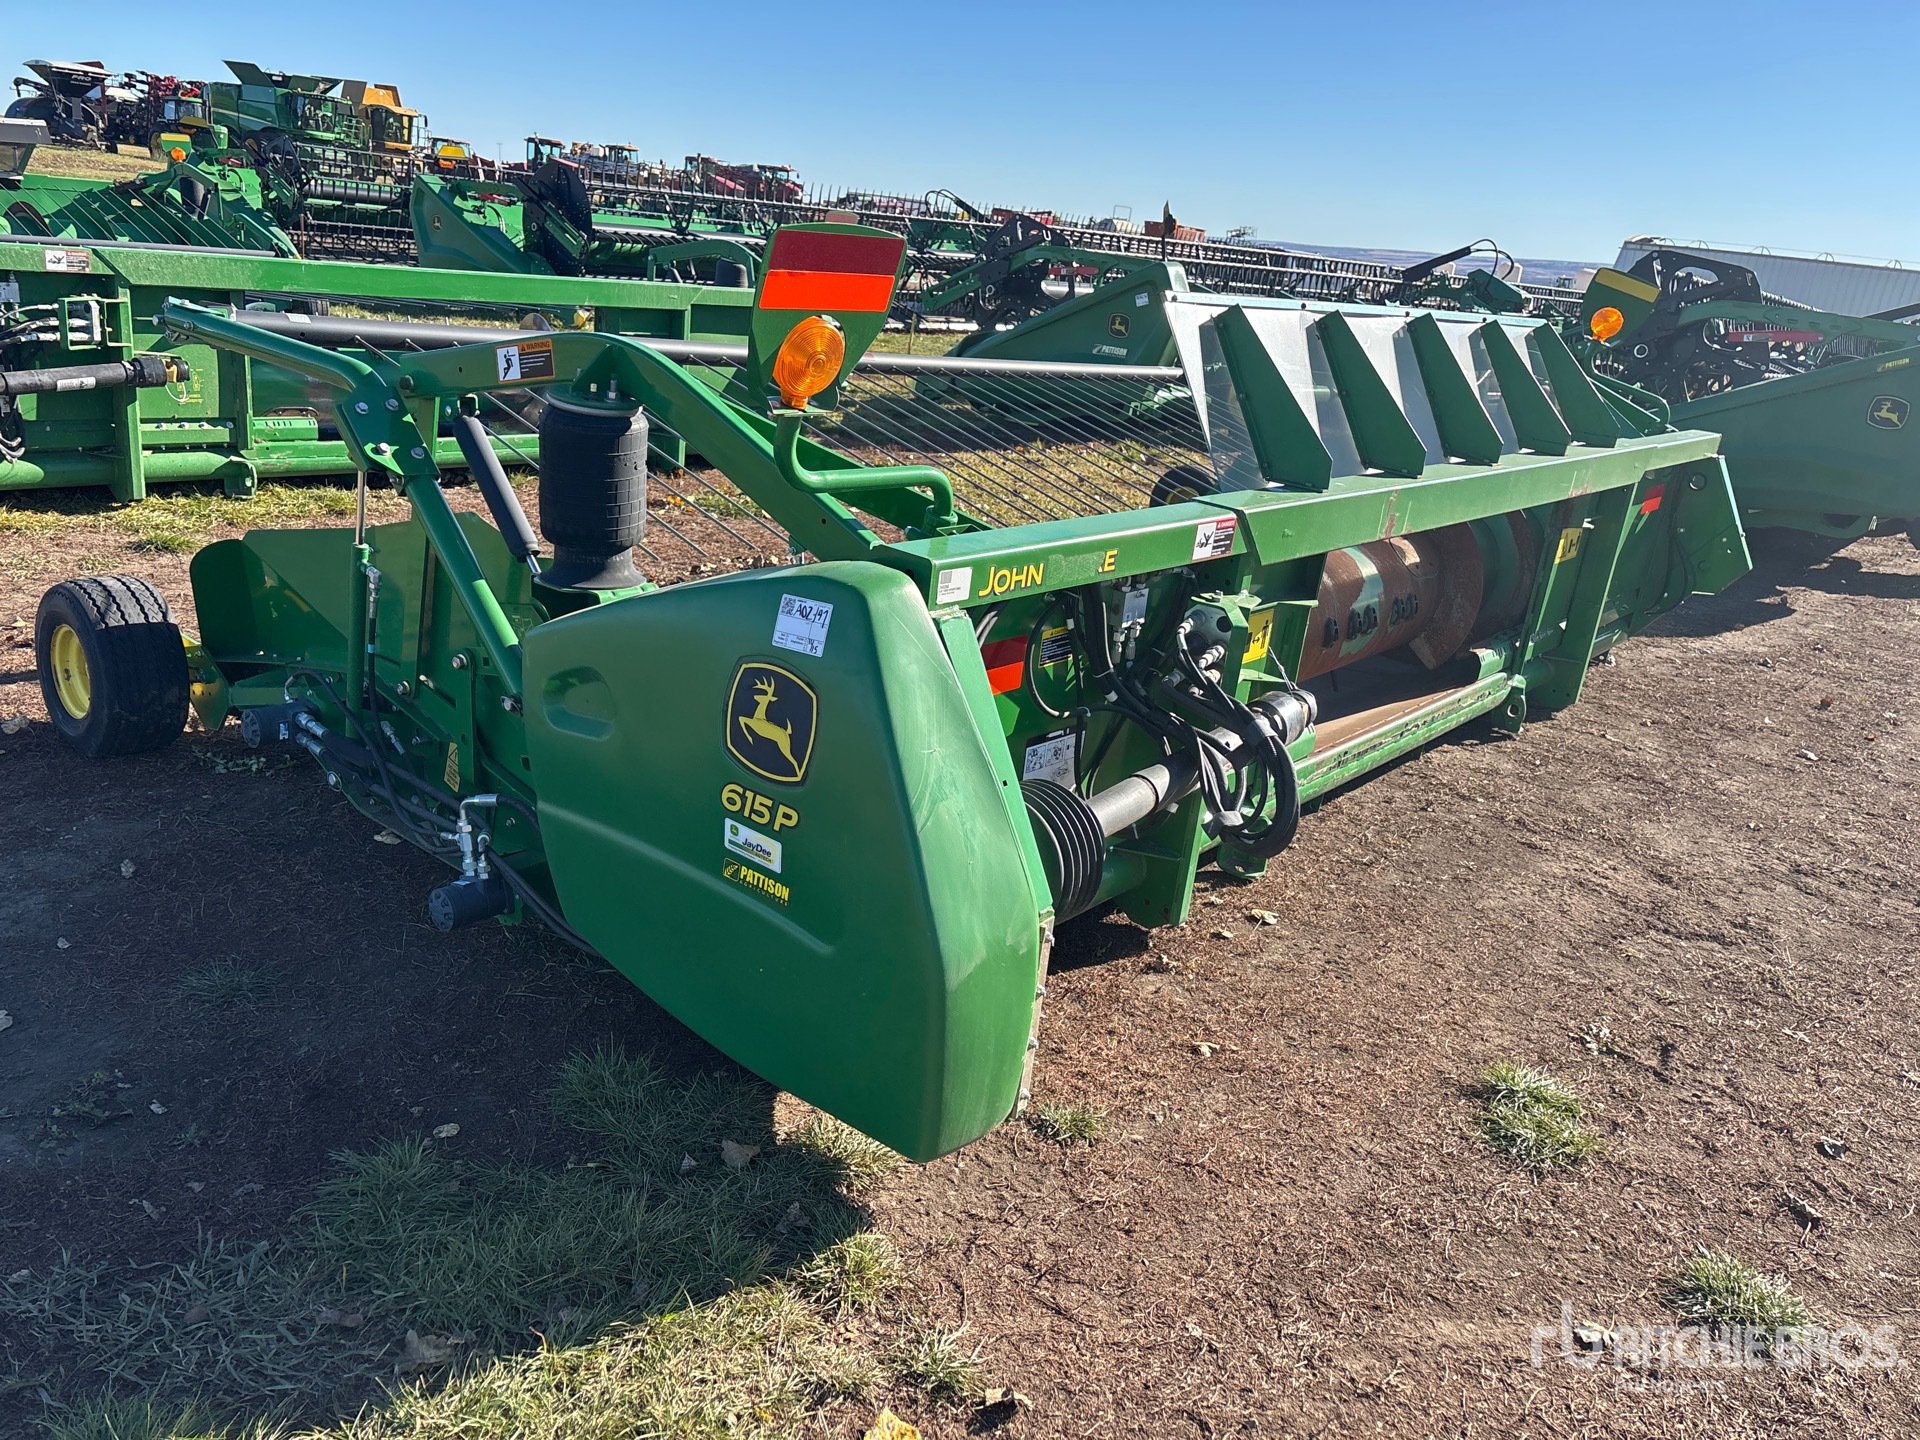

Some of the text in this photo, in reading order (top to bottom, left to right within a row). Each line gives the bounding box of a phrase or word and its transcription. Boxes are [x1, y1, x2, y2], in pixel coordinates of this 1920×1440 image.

[526, 341, 549, 350] WARNING
[978, 562, 1045, 599] JOHN
[741, 838, 772, 858] JayDee
[740, 865, 790, 901] PATTISON
